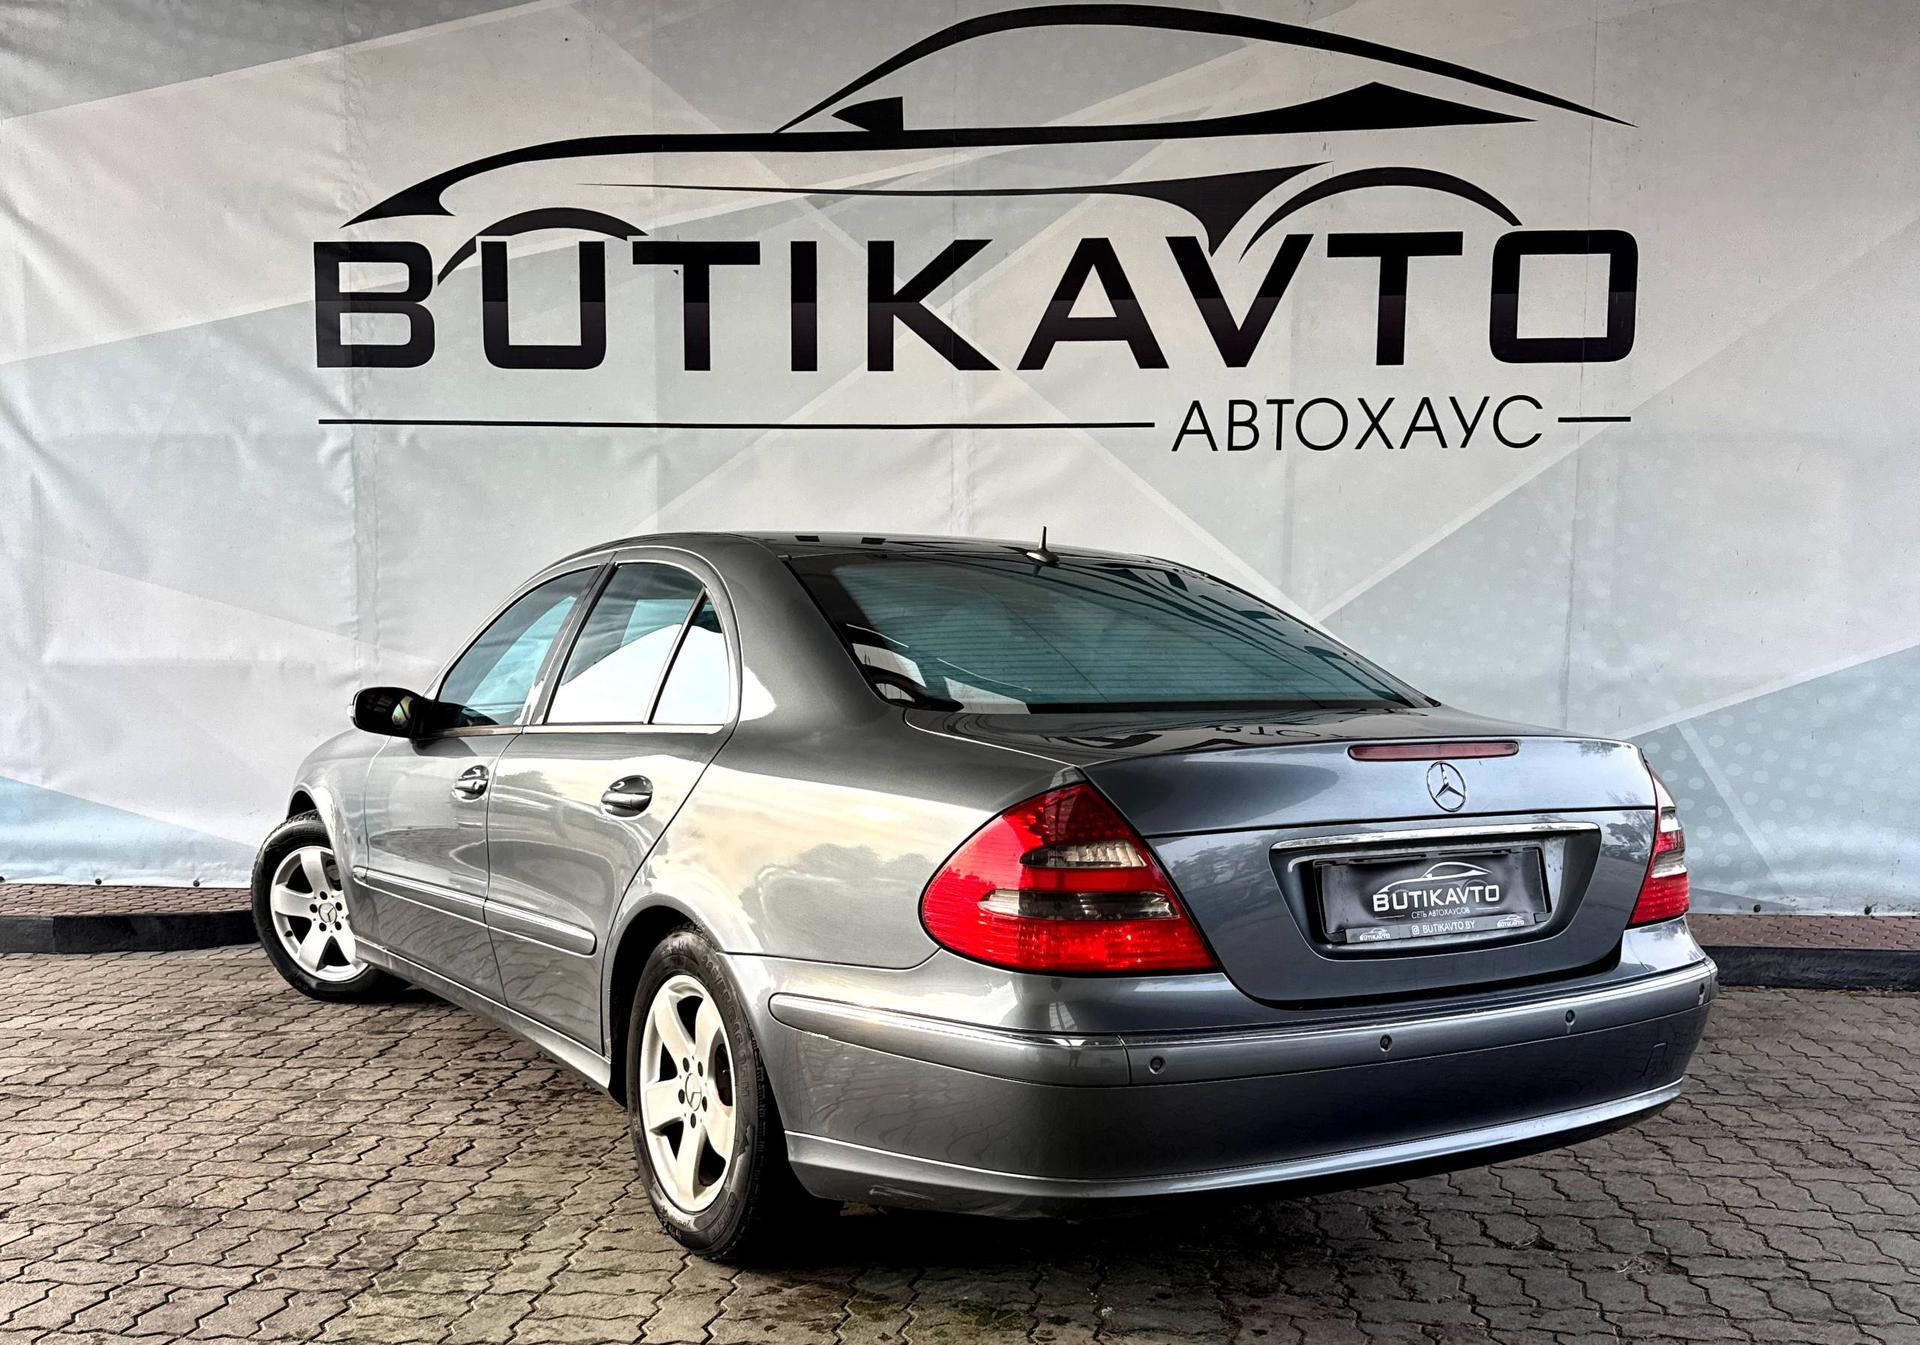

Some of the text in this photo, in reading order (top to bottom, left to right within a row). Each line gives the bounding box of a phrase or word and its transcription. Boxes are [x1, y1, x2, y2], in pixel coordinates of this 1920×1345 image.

[313, 229, 1639, 372] BUTIKAVTO
[1171, 394, 1544, 453] АВТОХАУС
[1372, 885, 1500, 912] BUTIKAVTO
[1411, 906, 1471, 919] СЕТЬ АВТОХАУСОВ
